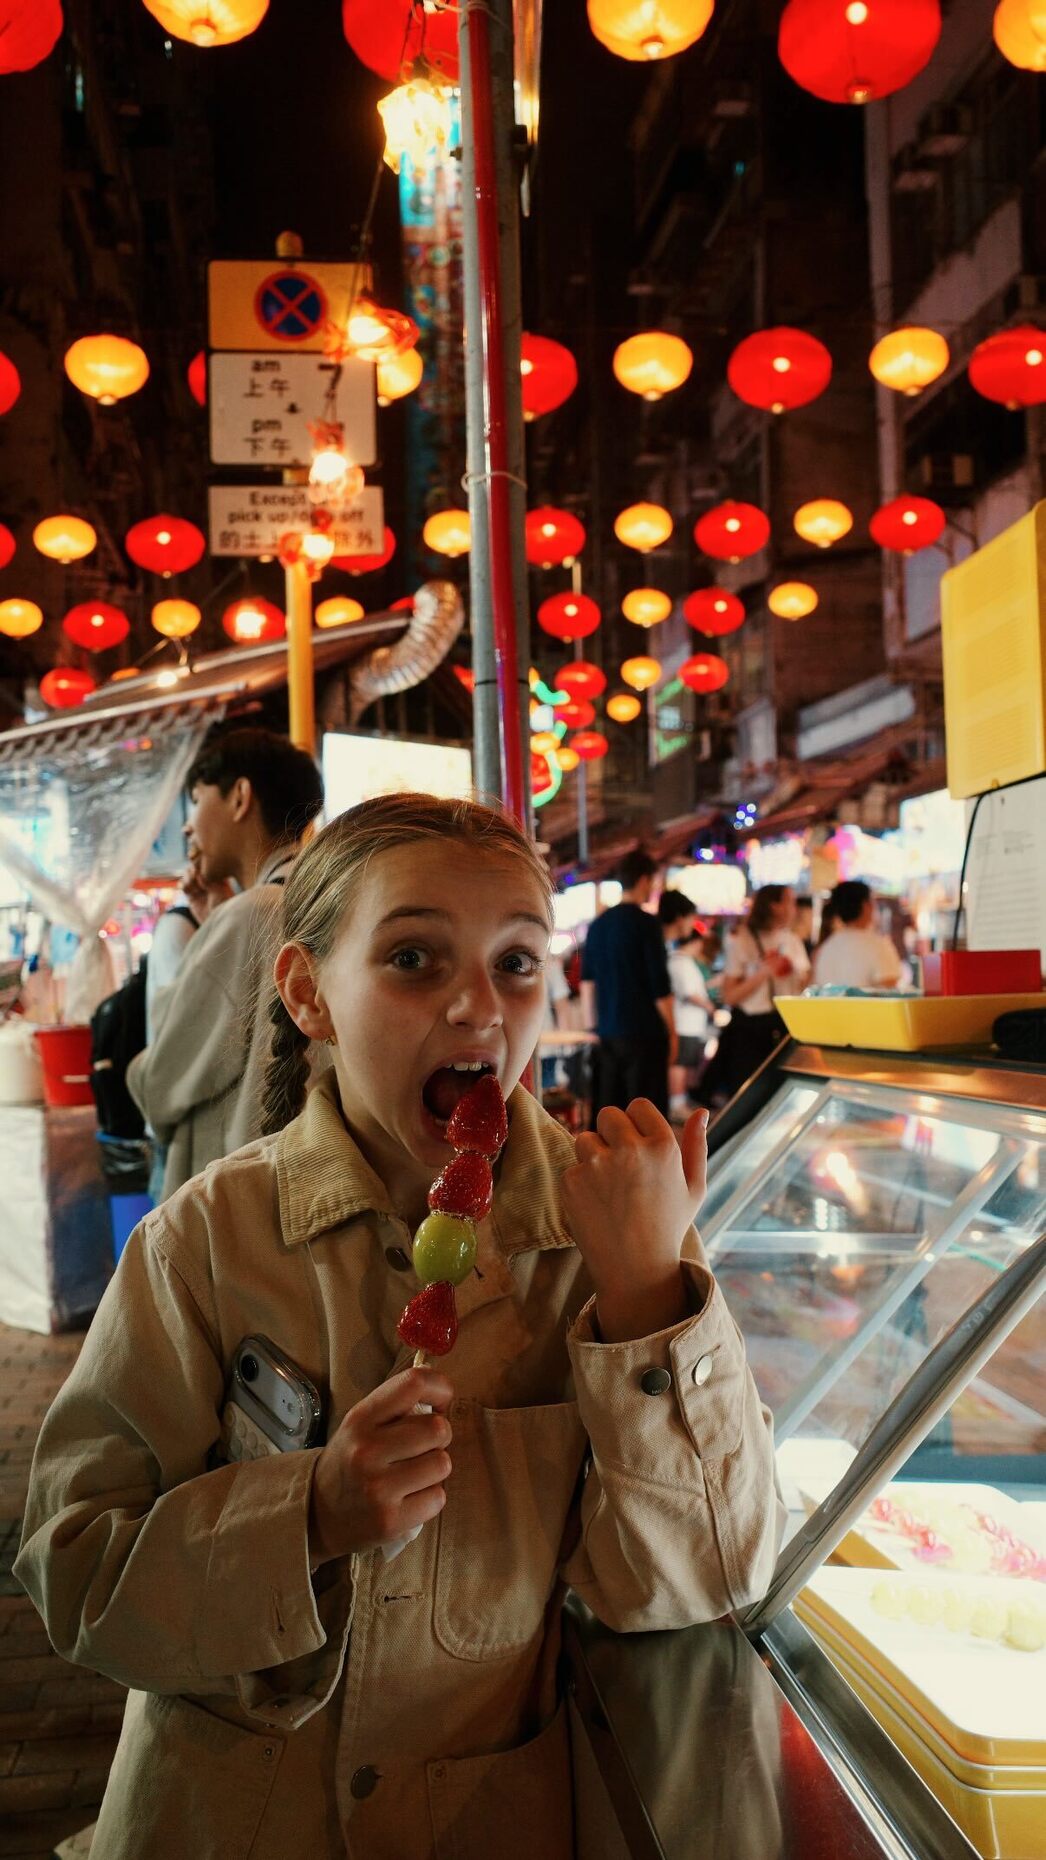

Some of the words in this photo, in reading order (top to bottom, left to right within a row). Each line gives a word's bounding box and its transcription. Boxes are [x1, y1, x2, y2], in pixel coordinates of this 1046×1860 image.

[252, 360, 281, 372] am
[244, 378, 290, 398] 上午
[318, 363, 342, 397] 7
[252, 419, 282, 433] pm
[244, 438, 290, 457] 下午
[228, 510, 261, 524] pick
[340, 509, 364, 522] off
